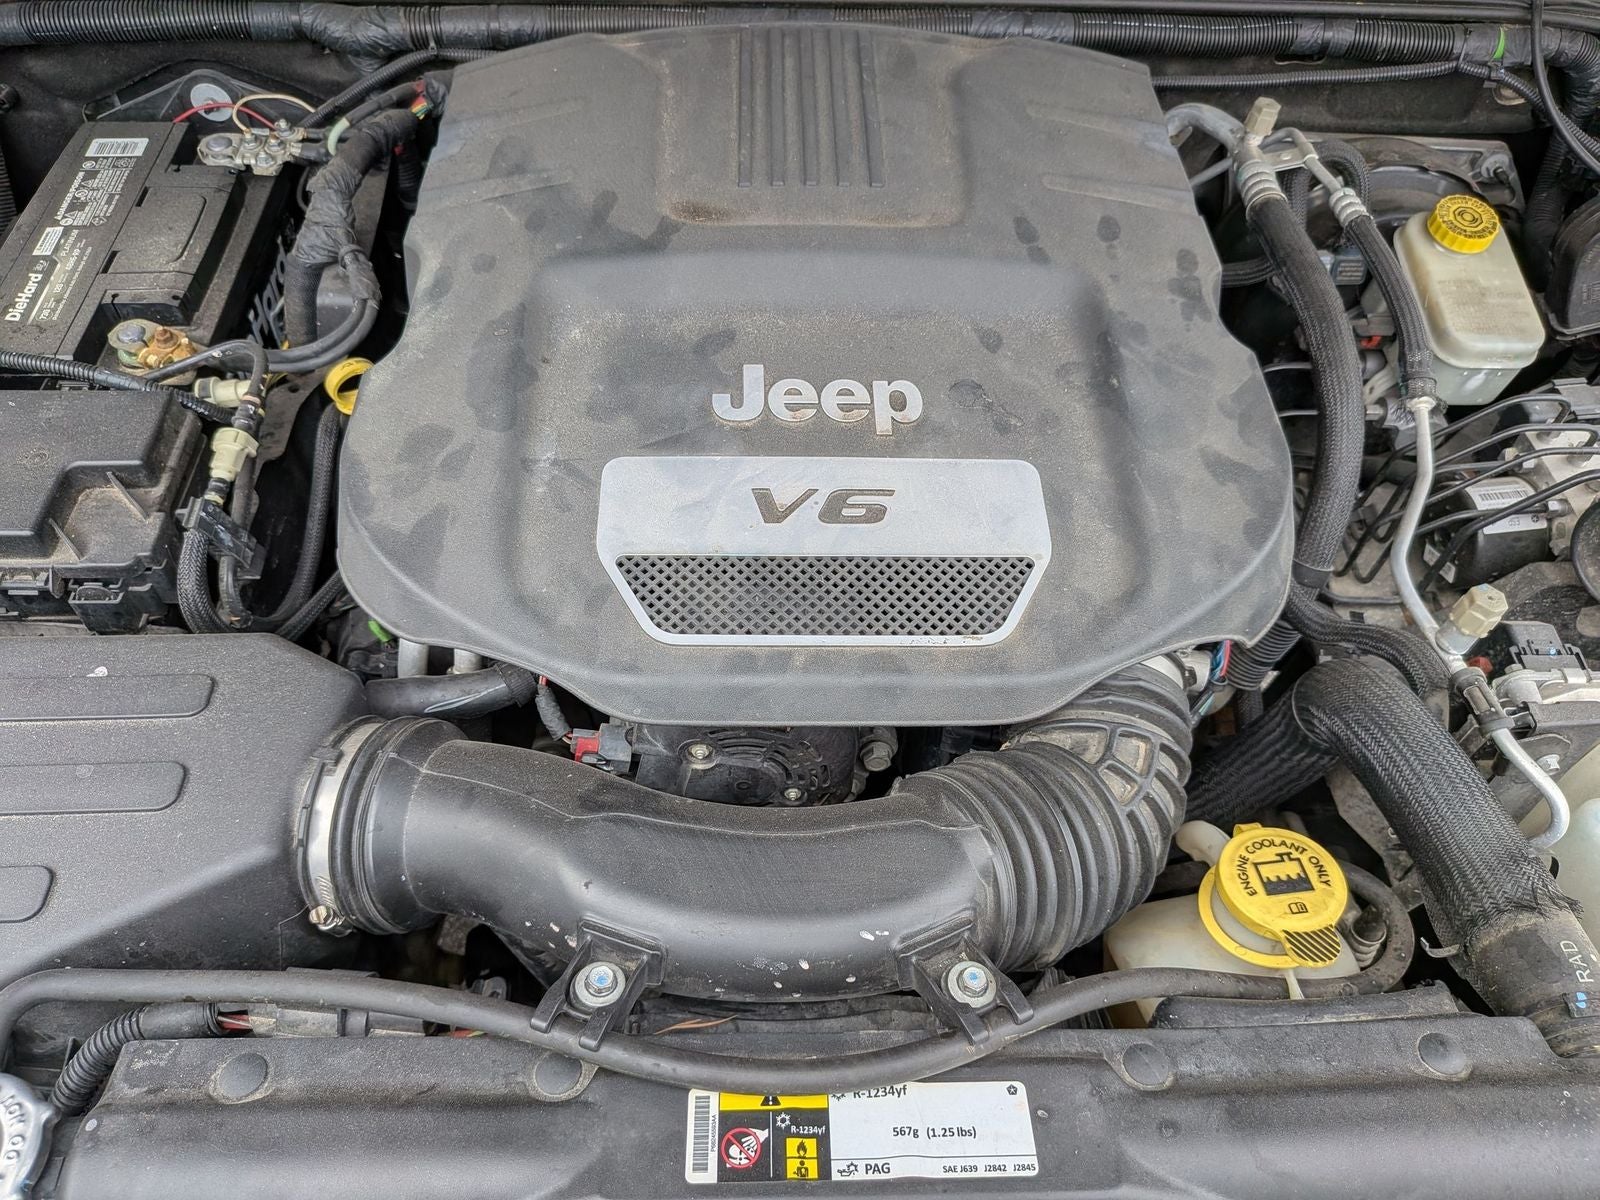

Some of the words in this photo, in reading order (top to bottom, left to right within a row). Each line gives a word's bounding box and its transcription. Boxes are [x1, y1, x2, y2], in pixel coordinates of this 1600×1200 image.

[60, 229, 79, 257] PLATINUM
[4, 273, 43, 322] DieHard
[711, 364, 923, 435] Jeep
[751, 487, 896, 525] V6
[1245, 838, 1308, 854] COOLANT
[1236, 854, 1258, 897] ENGINE
[1308, 856, 1332, 887] ONLY
[1560, 940, 1595, 983] RAD
[853, 1084, 908, 1099] R-1234yf
[790, 1124, 826, 1136] R-1234yf
[892, 1126, 919, 1139] 567g
[926, 1127, 955, 1139] (1.25
[957, 1126, 977, 1139] lbs)
[864, 1162, 891, 1175] PAG
[942, 1165, 958, 1173] SAE
[960, 1165, 978, 1173] J639
[984, 1164, 1007, 1173] J2842
[1013, 1163, 1036, 1172] J2845
